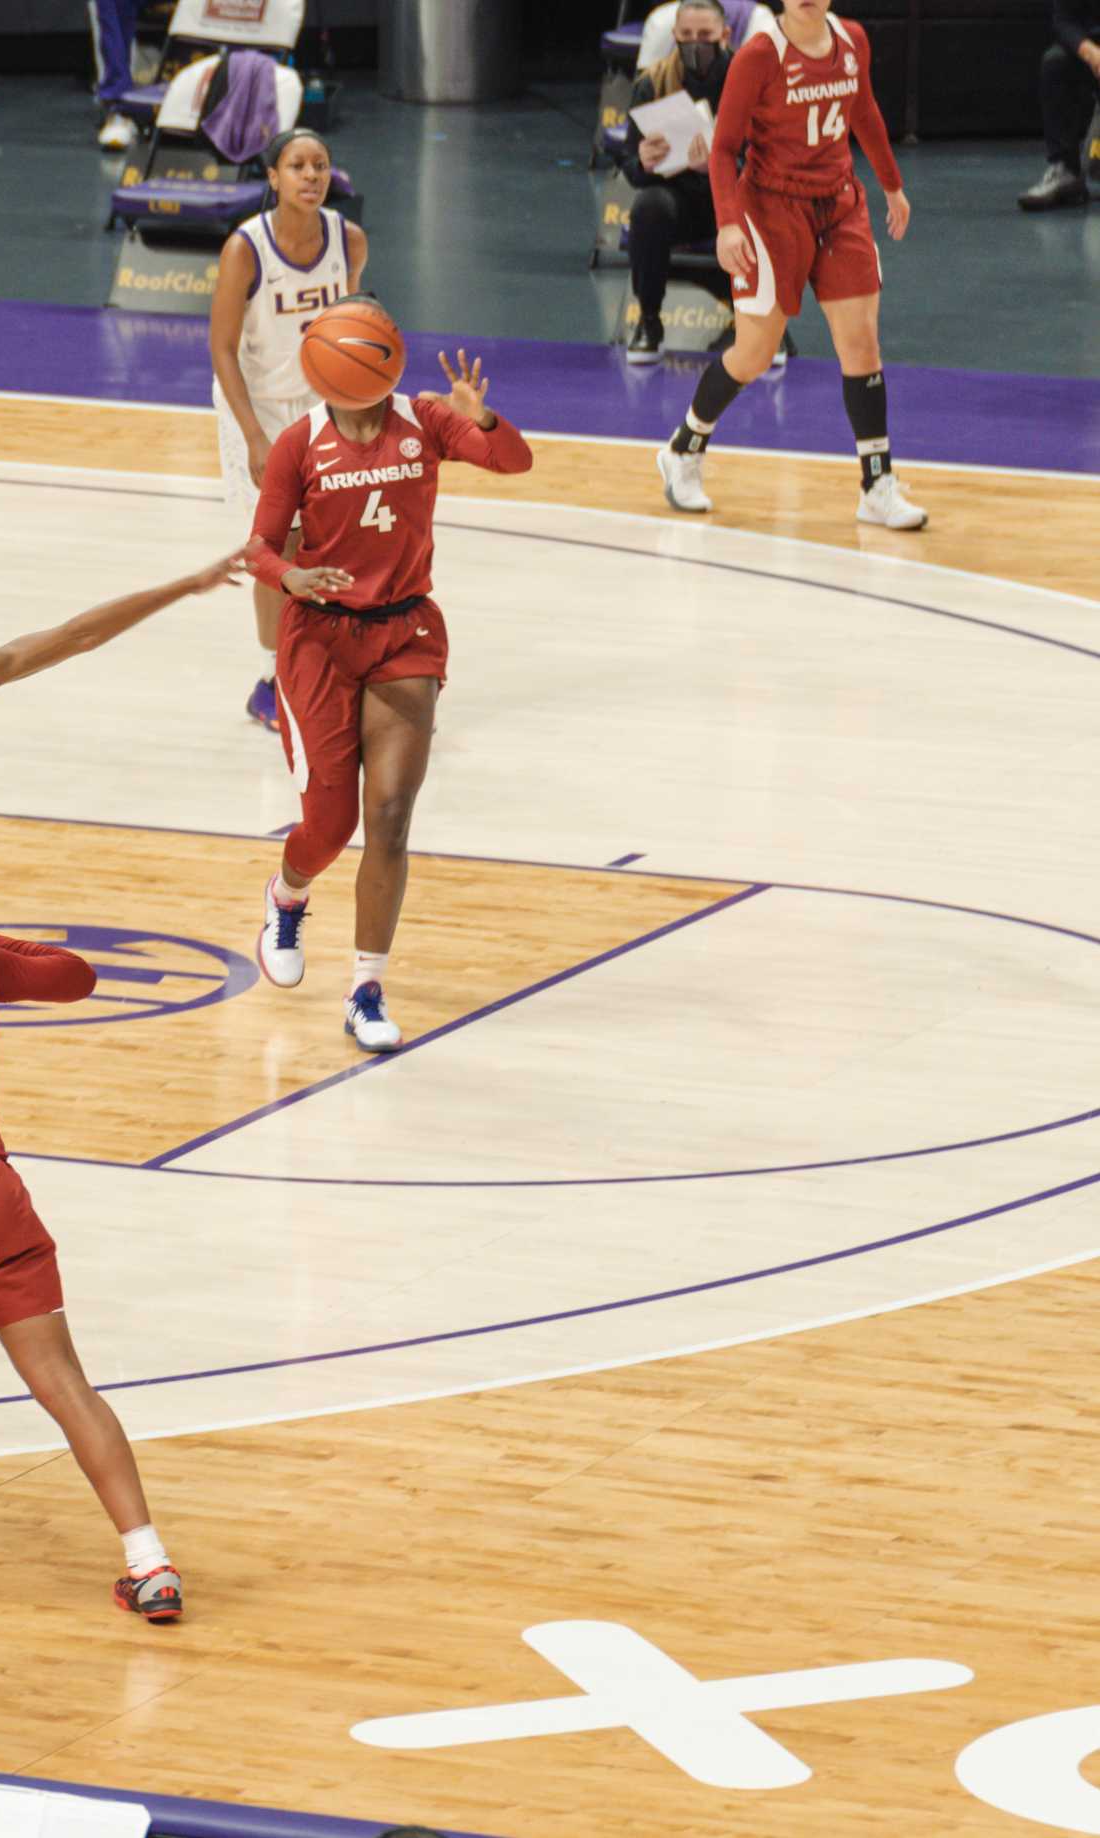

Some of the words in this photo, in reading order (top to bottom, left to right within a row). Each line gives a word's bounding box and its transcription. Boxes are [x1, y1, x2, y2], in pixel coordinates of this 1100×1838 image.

[807, 101, 845, 146] 14
[117, 264, 218, 296] RoofClai
[275, 282, 339, 315] LSU
[321, 462, 423, 492] ARKANSAS
[359, 489, 397, 533] 4
